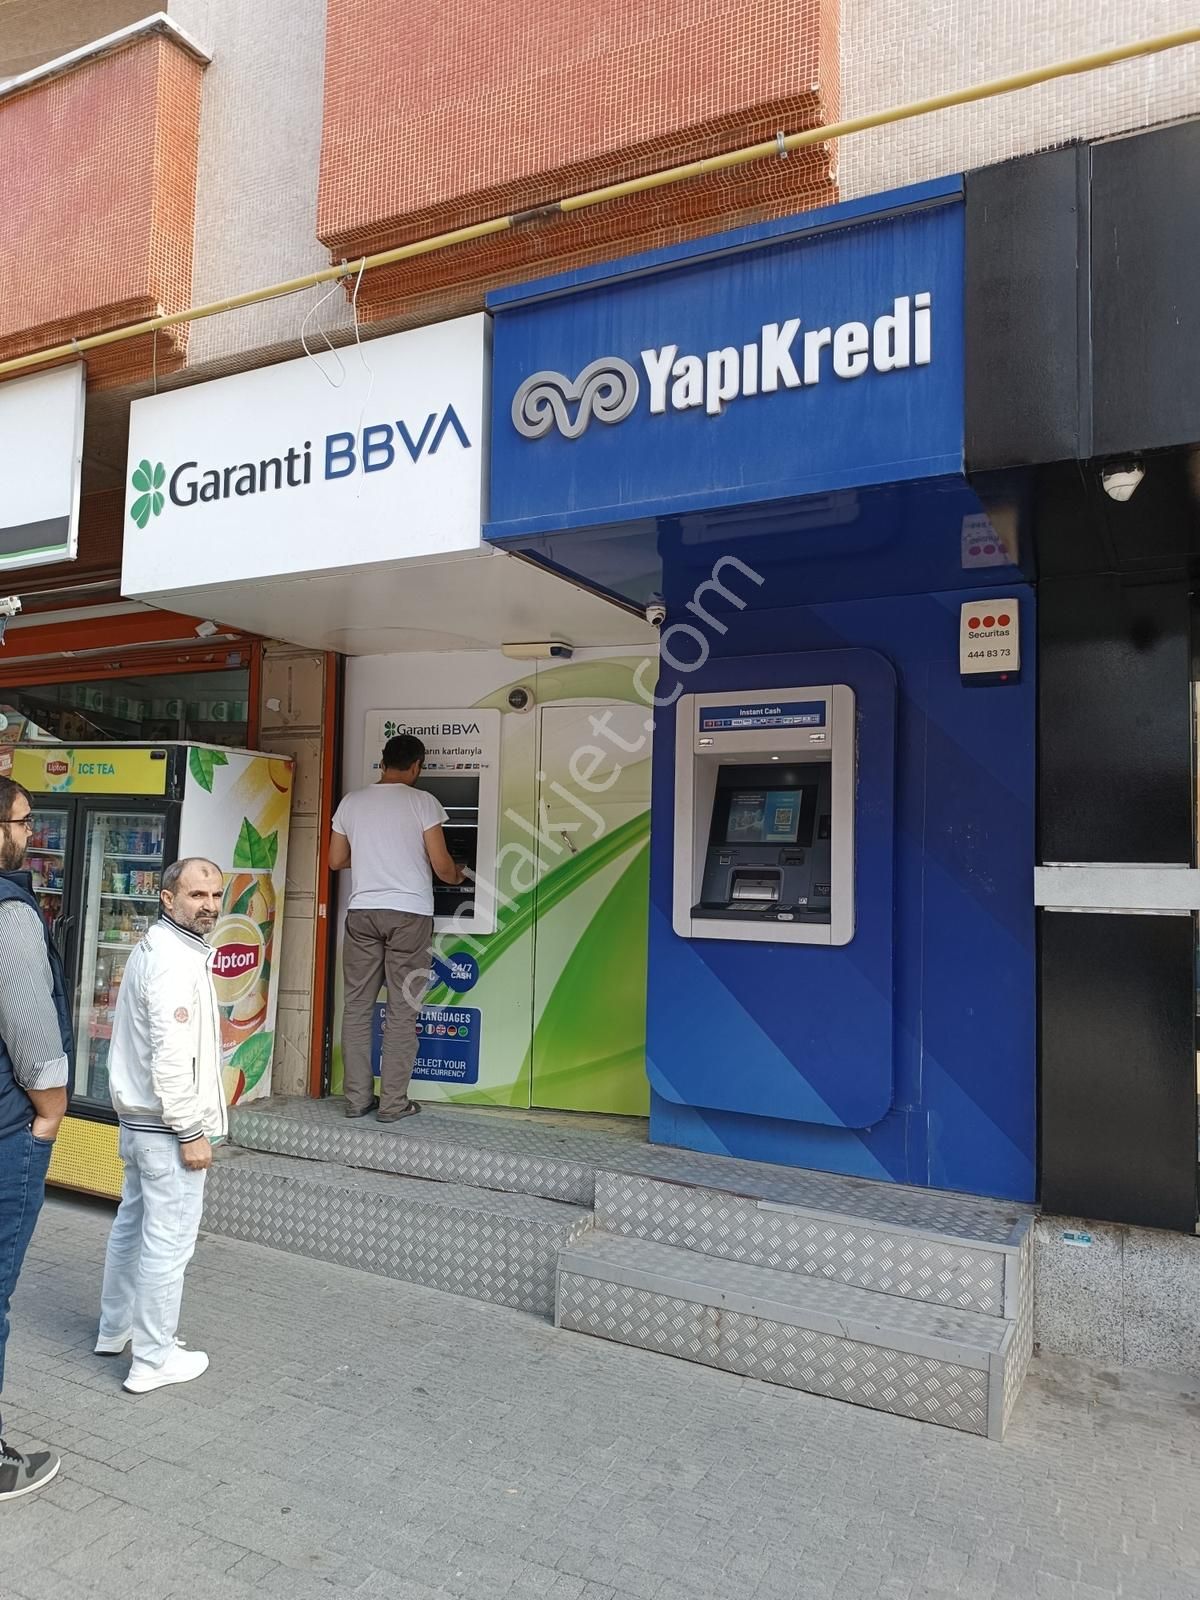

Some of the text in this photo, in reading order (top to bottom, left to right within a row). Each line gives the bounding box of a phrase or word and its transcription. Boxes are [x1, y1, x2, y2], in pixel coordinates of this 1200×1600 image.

[641, 292, 931, 415] YapıKredi
[168, 402, 473, 508] Garanti BBVA
[968, 630, 1010, 639] Securitas
[1000, 648, 1012, 657] 73
[739, 706, 782, 717] Instant Cash
[397, 723, 480, 735] Garanti BBVA
[442, 747, 482, 757] kartlarıyla
[78, 763, 114, 774] ICE TEA
[451, 963, 473, 972] 24/7
[450, 972, 473, 980] CASH
[421, 1012, 471, 1023] LANGUAGES
[443, 1060, 466, 1070] YOUR
[430, 1069, 466, 1079] CURRENCY
